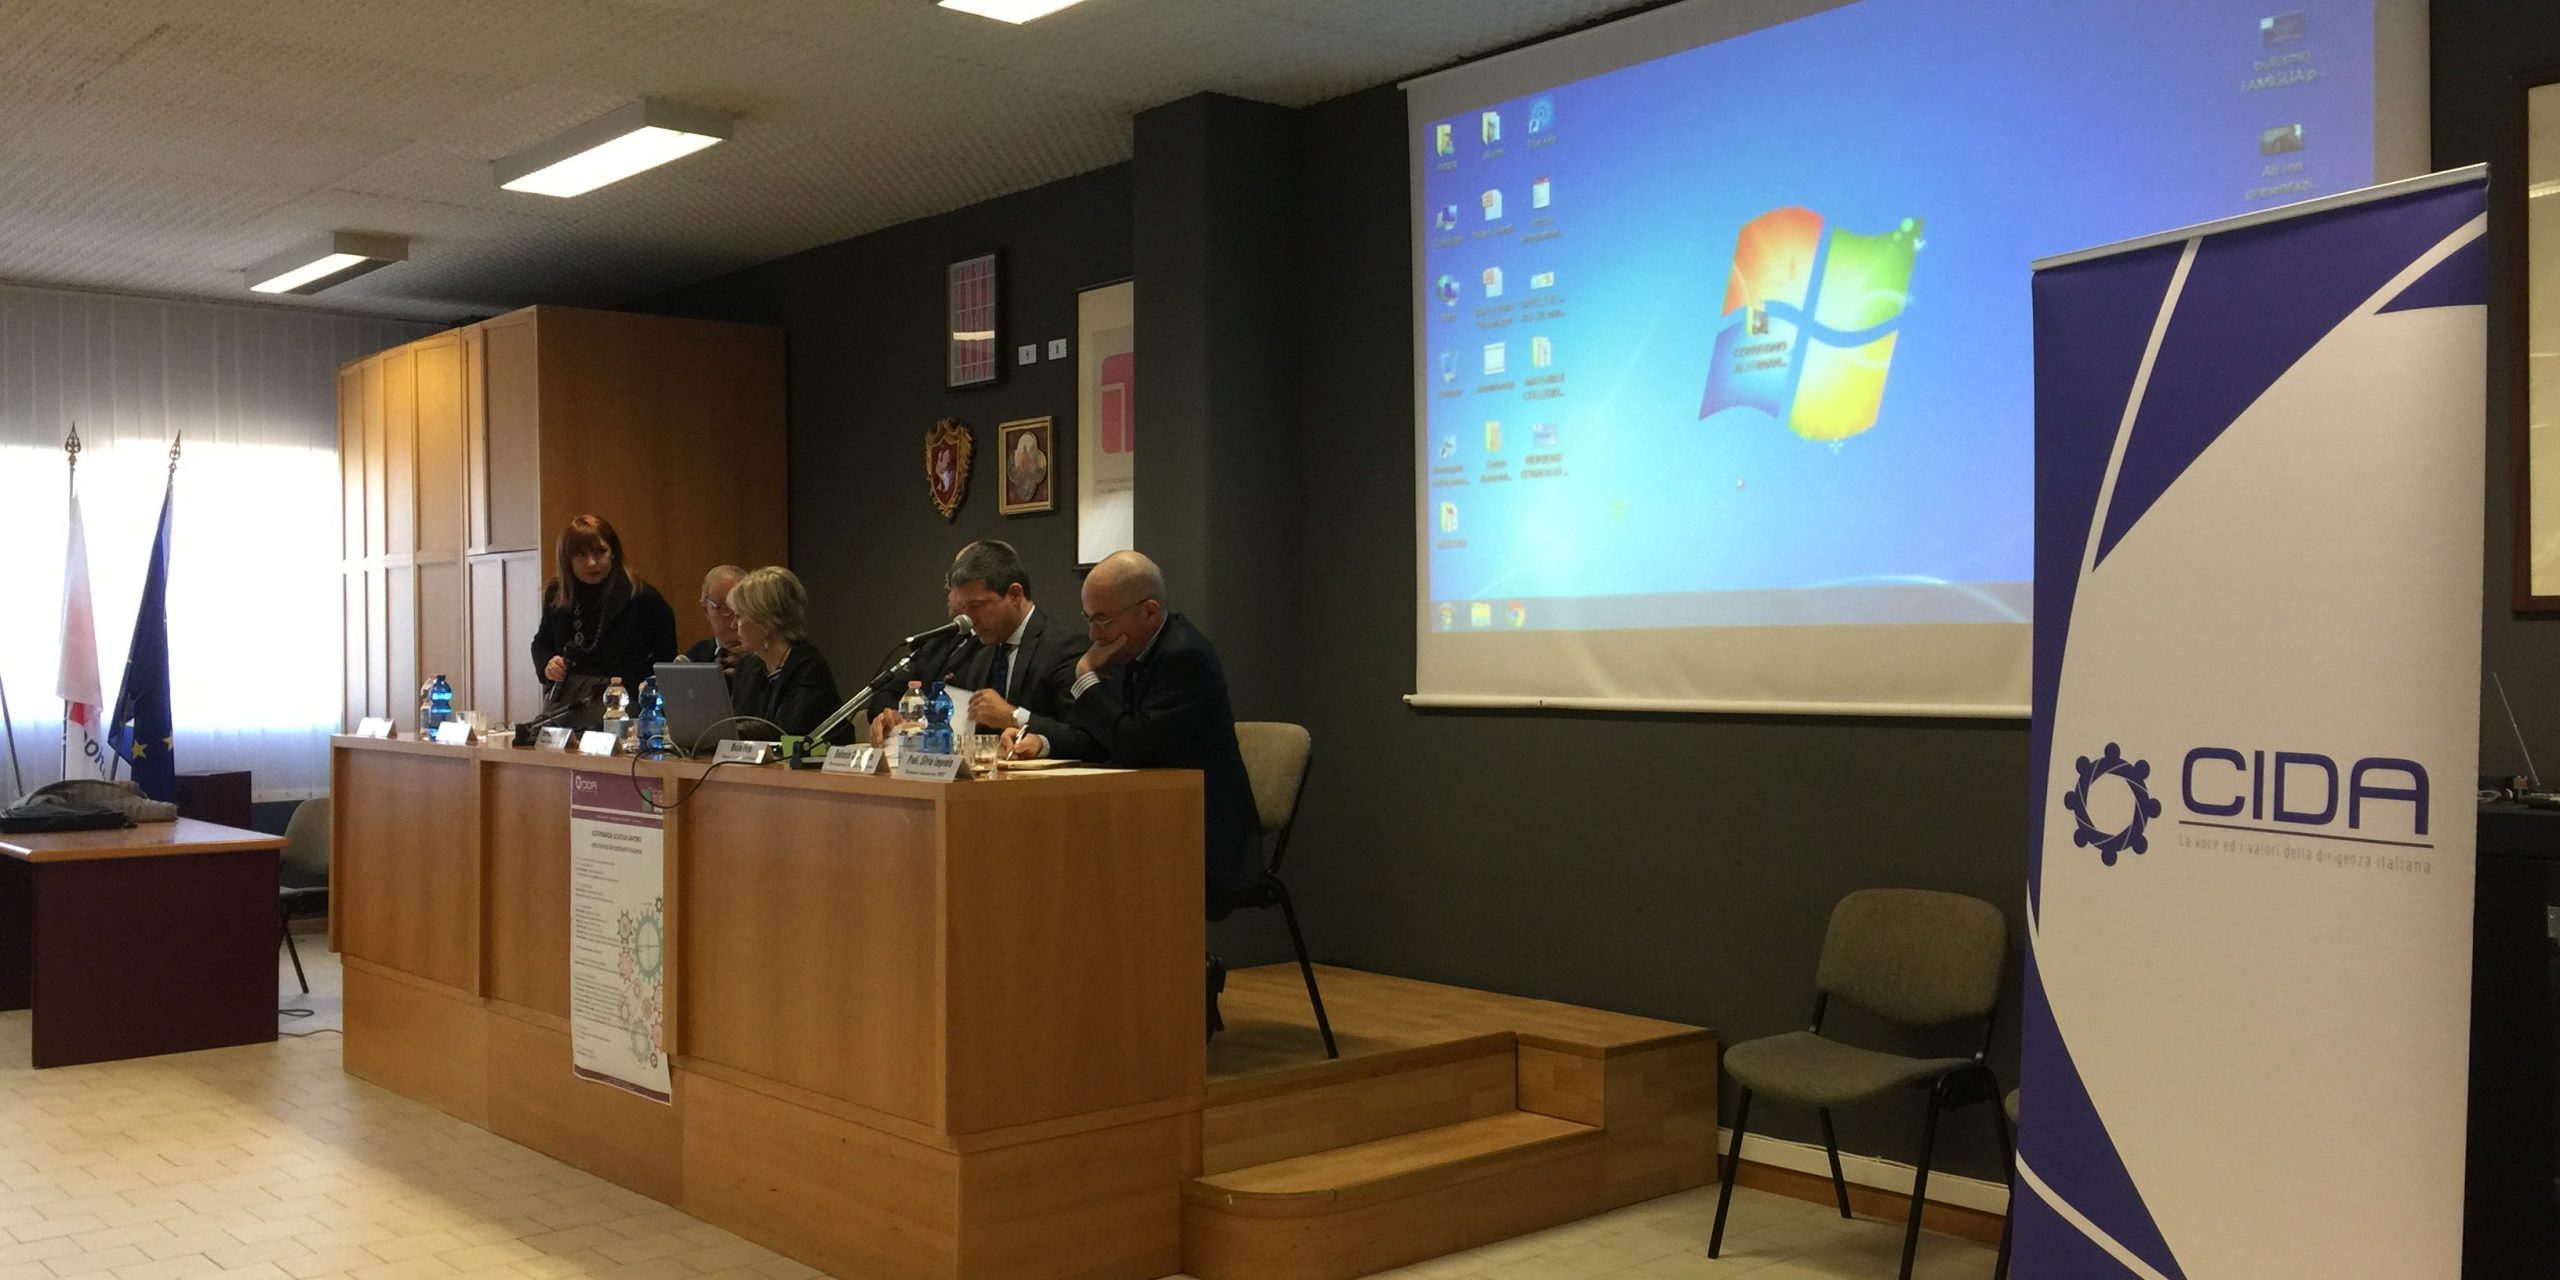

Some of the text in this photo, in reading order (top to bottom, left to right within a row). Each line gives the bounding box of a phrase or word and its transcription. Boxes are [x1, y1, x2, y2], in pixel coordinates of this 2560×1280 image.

[2182, 746, 2430, 835] CIDA
[2179, 833, 2191, 848] La
[2195, 838, 2219, 851] voce
[2223, 839, 2236, 853] ed
[2247, 842, 2280, 857] valori
[2283, 844, 2312, 862] della
[2316, 847, 2371, 869] dirigenza
[2376, 854, 2431, 874] italiana
